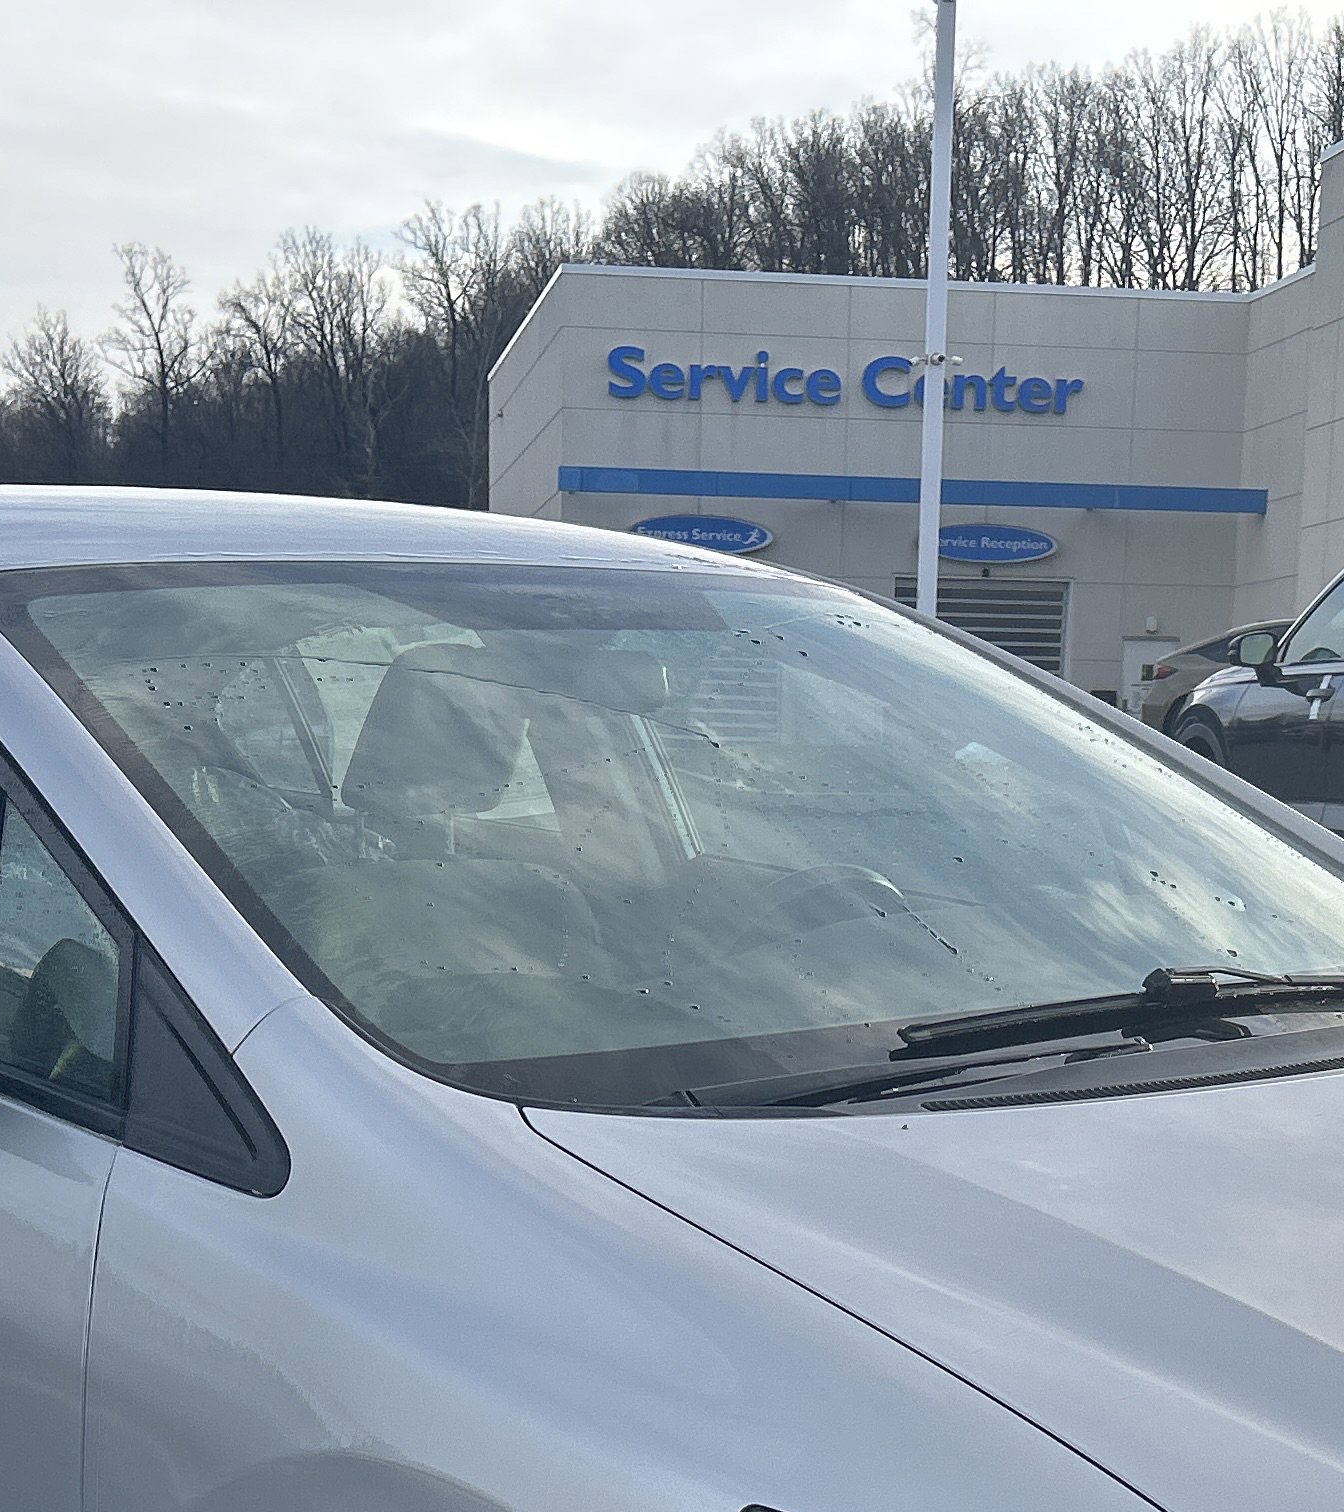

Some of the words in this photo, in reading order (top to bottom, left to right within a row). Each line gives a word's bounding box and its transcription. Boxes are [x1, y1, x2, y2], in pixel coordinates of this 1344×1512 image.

[607, 345, 842, 406] Service
[691, 528, 742, 542] Service
[939, 535, 977, 548] ervice
[980, 536, 1049, 553] Reception
